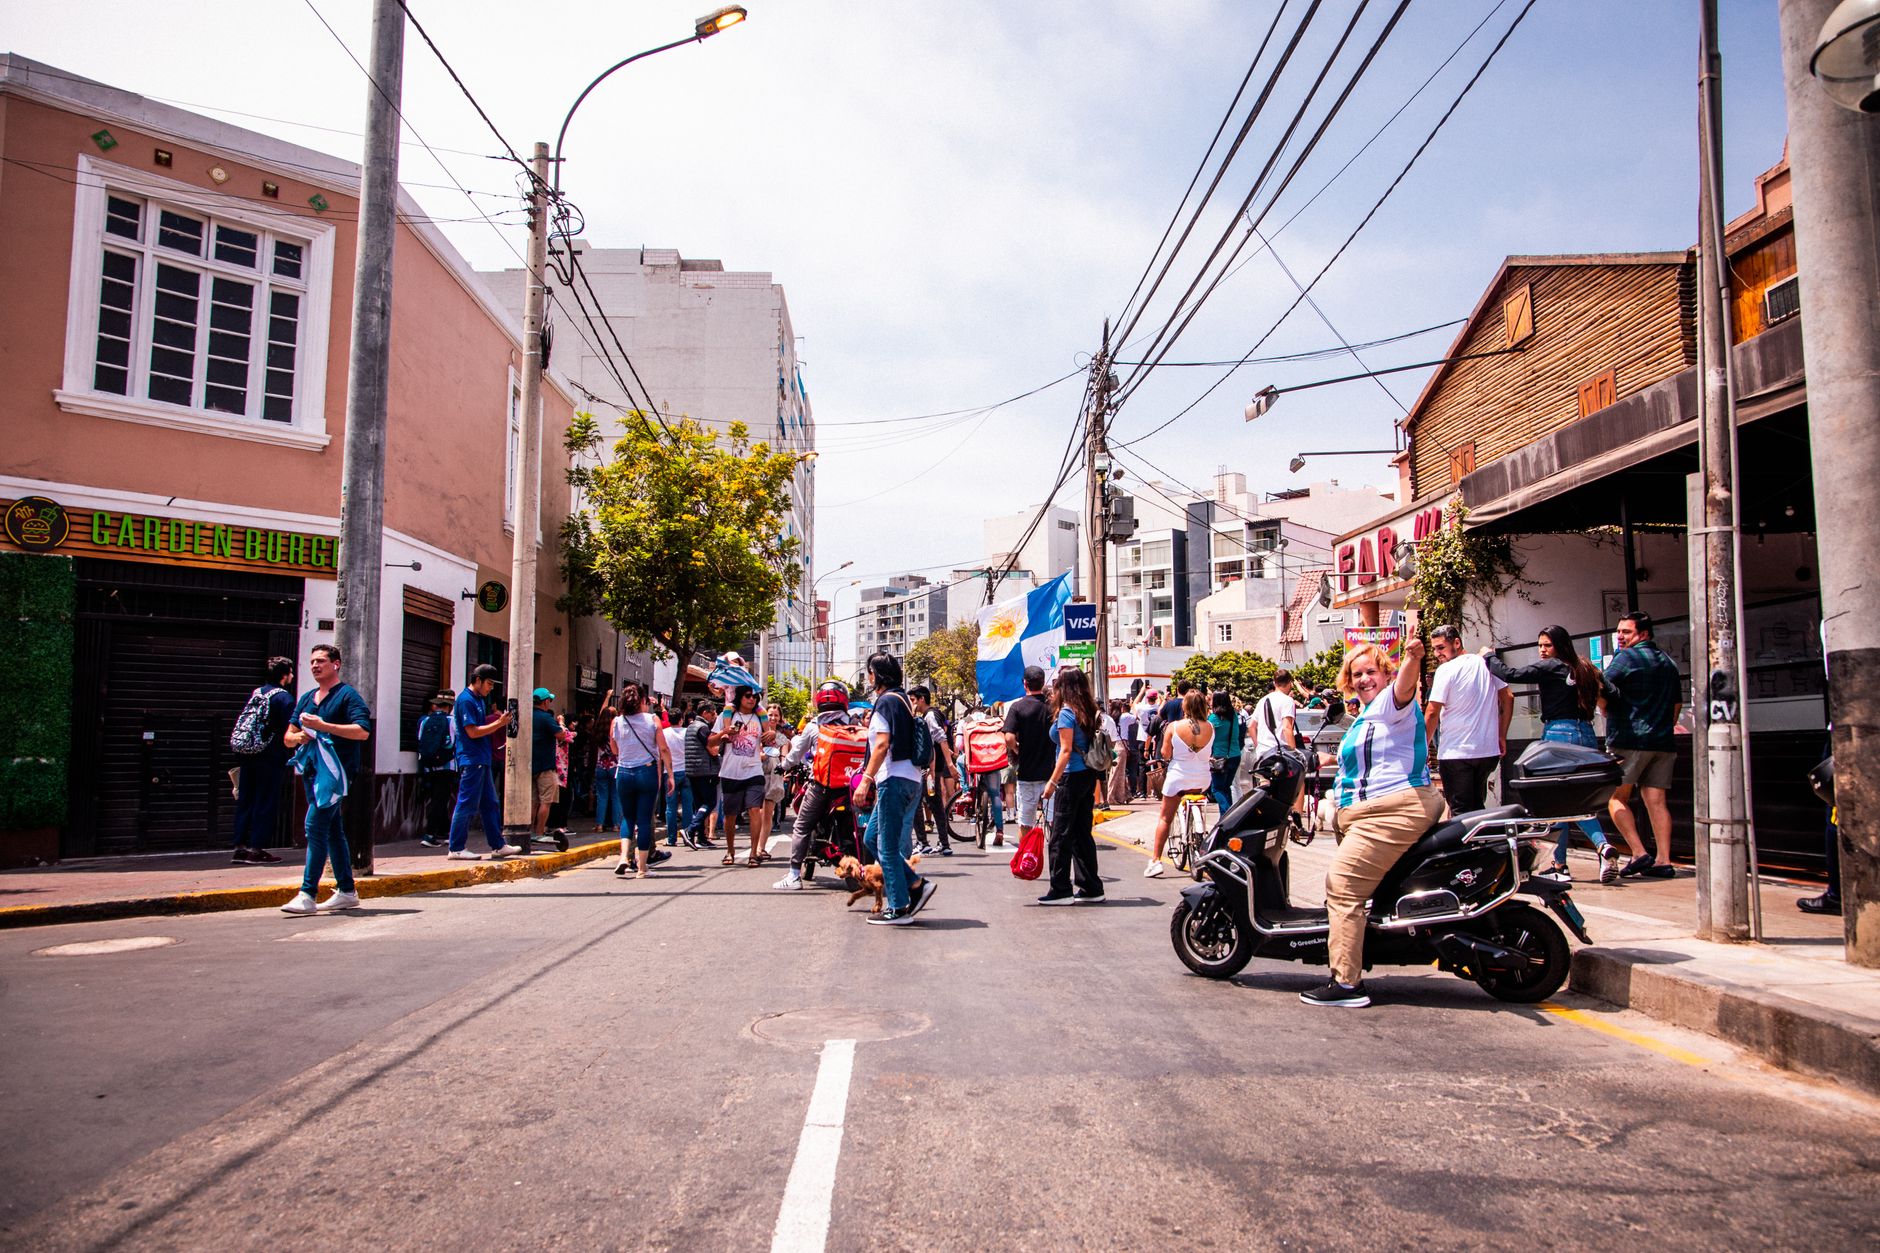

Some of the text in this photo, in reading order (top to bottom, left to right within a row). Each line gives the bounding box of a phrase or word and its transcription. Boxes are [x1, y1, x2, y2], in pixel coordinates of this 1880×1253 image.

[92, 511, 233, 558] GARDEN
[1338, 526, 1398, 592] FAR
[1067, 617, 1097, 629] VISA
[1347, 629, 1398, 642] PROMOCIÓN
